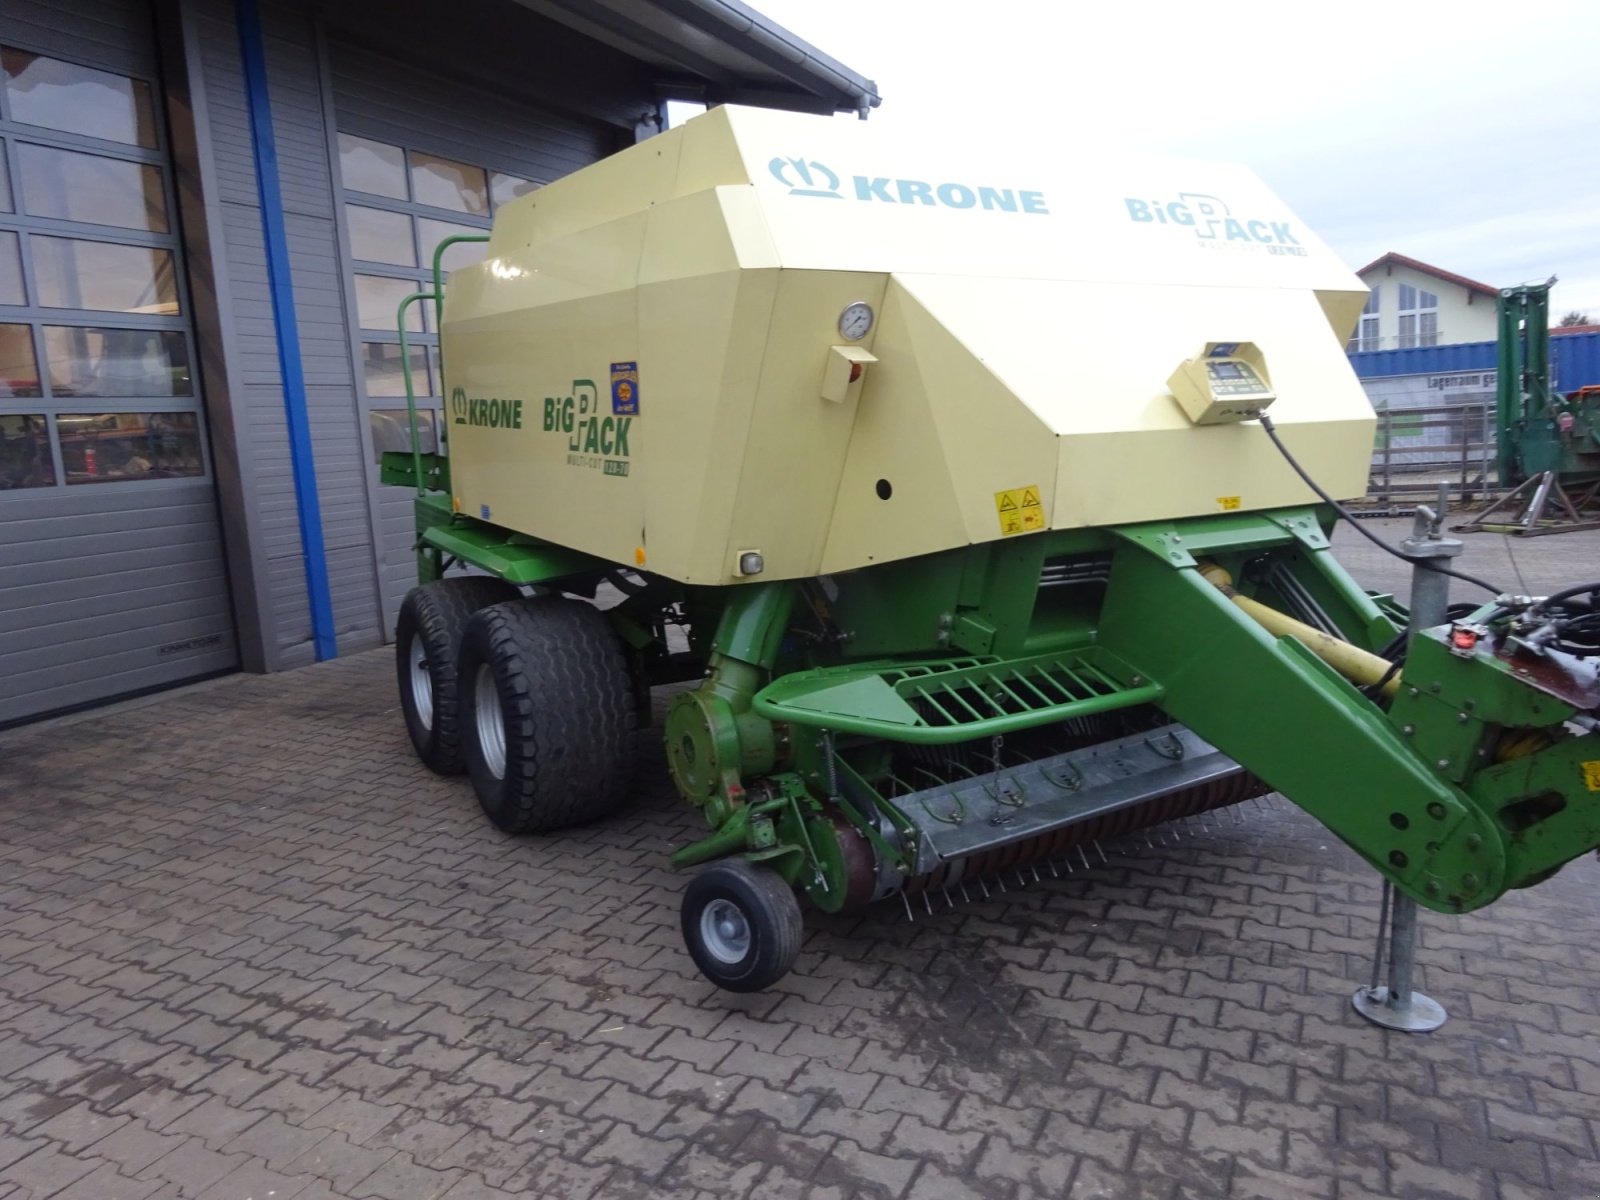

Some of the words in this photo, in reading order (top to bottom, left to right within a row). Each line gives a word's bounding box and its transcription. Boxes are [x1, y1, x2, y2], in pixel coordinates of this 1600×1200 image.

[852, 175, 1050, 215] KRONE
[1178, 192, 1301, 246] PACK
[1428, 375, 1480, 390] Lagerraum
[1483, 373, 1497, 388] ge
[469, 398, 522, 429] KRONE
[543, 397, 575, 433] BiG
[569, 379, 631, 456] PACK
